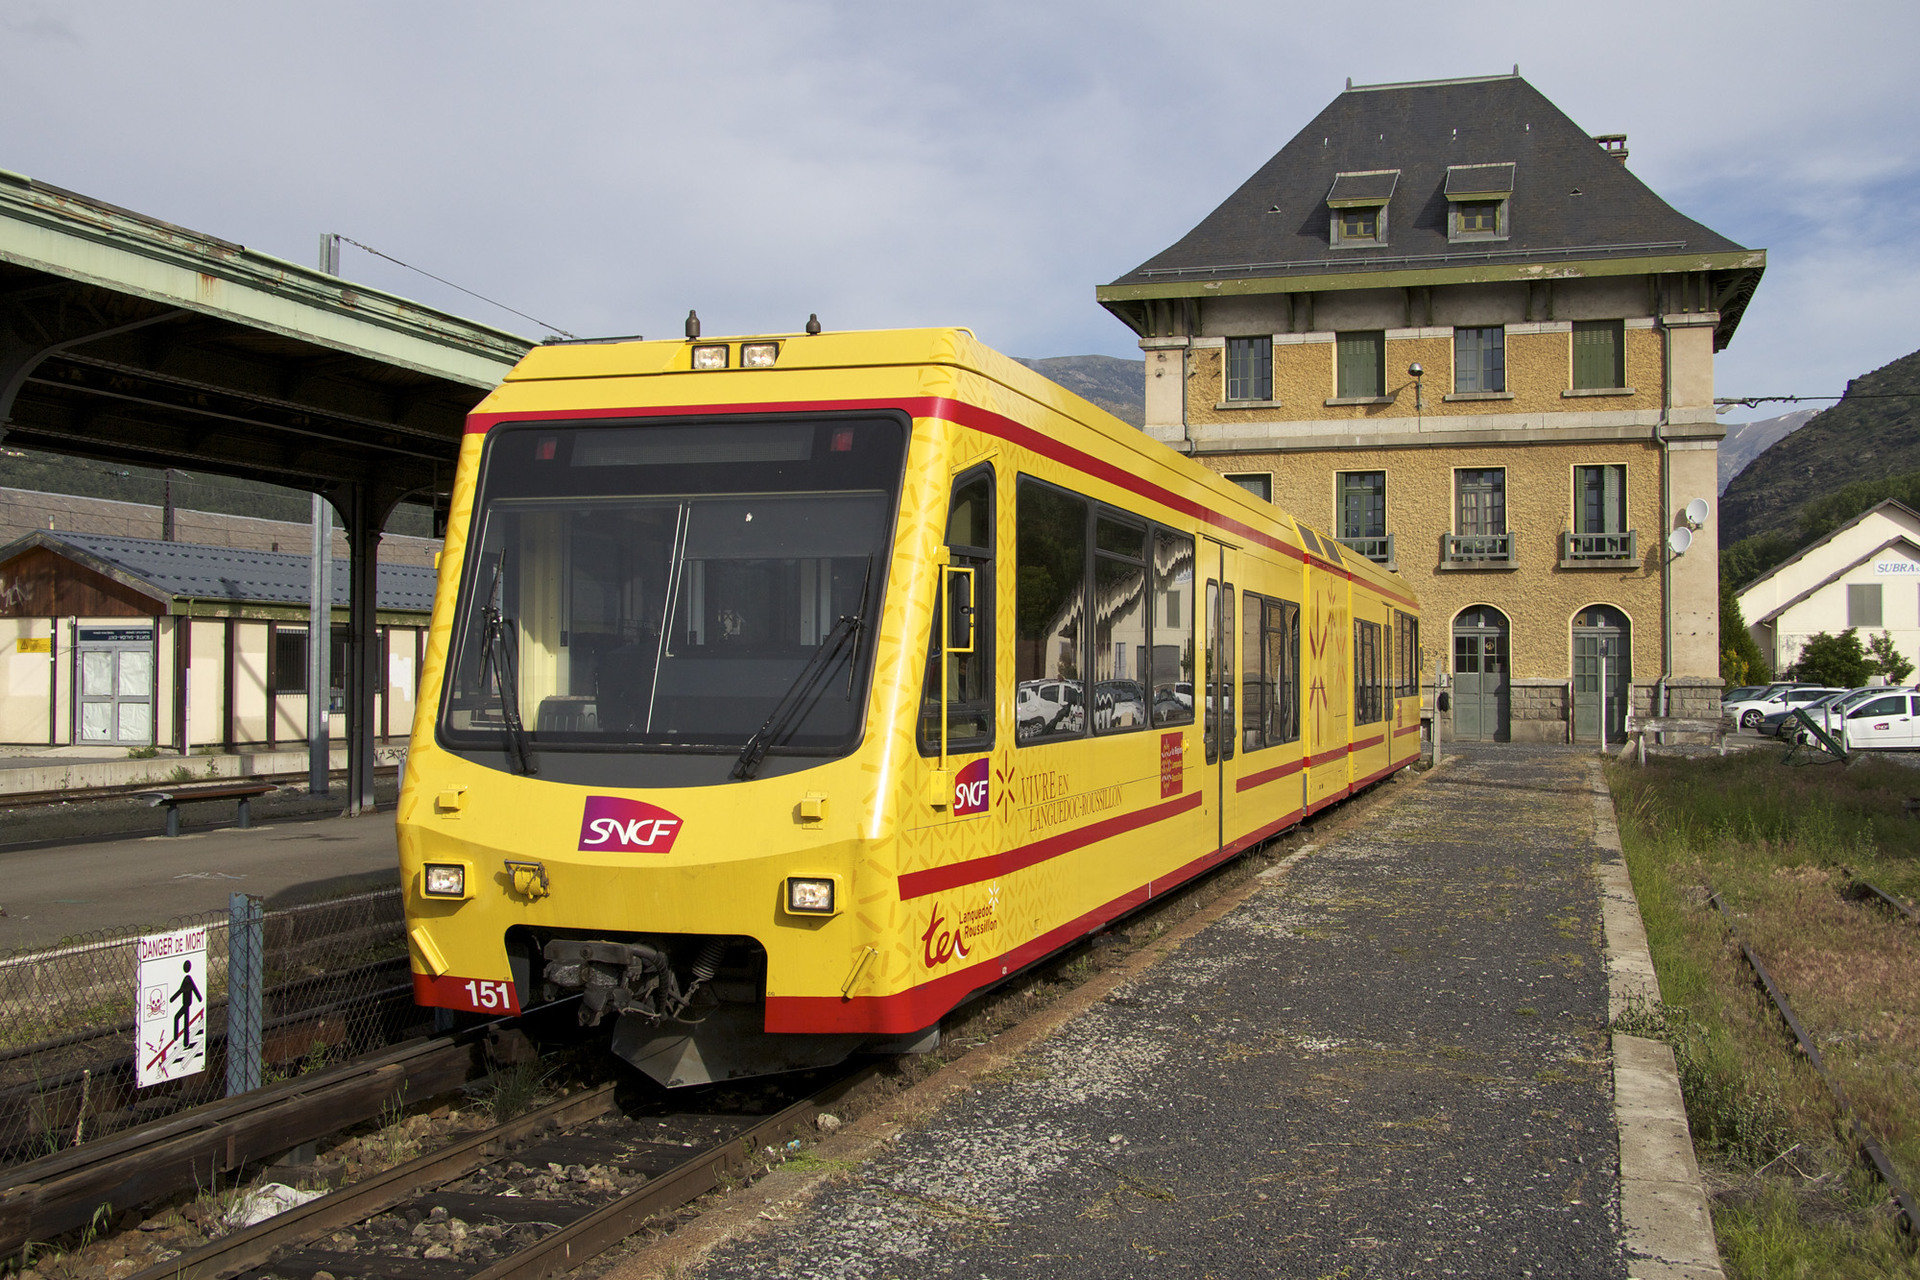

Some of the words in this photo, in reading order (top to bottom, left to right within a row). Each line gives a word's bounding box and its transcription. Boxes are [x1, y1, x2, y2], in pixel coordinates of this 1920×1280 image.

[1877, 563, 1915, 573] SUBRA
[954, 780, 988, 809] SNCF
[1021, 770, 1056, 805] VIVRE
[1058, 773, 1069, 796] EN
[1029, 785, 1122, 832] LANGUEDOC-ROUSSILLON
[583, 818, 678, 846] SNCF
[958, 904, 993, 924] Languedoc
[921, 901, 971, 969] ter
[964, 918, 998, 939] Roussillon
[142, 937, 173, 959] DANGER
[175, 938, 183, 953] DE
[185, 931, 205, 951] MORT
[465, 980, 510, 1008] 151
